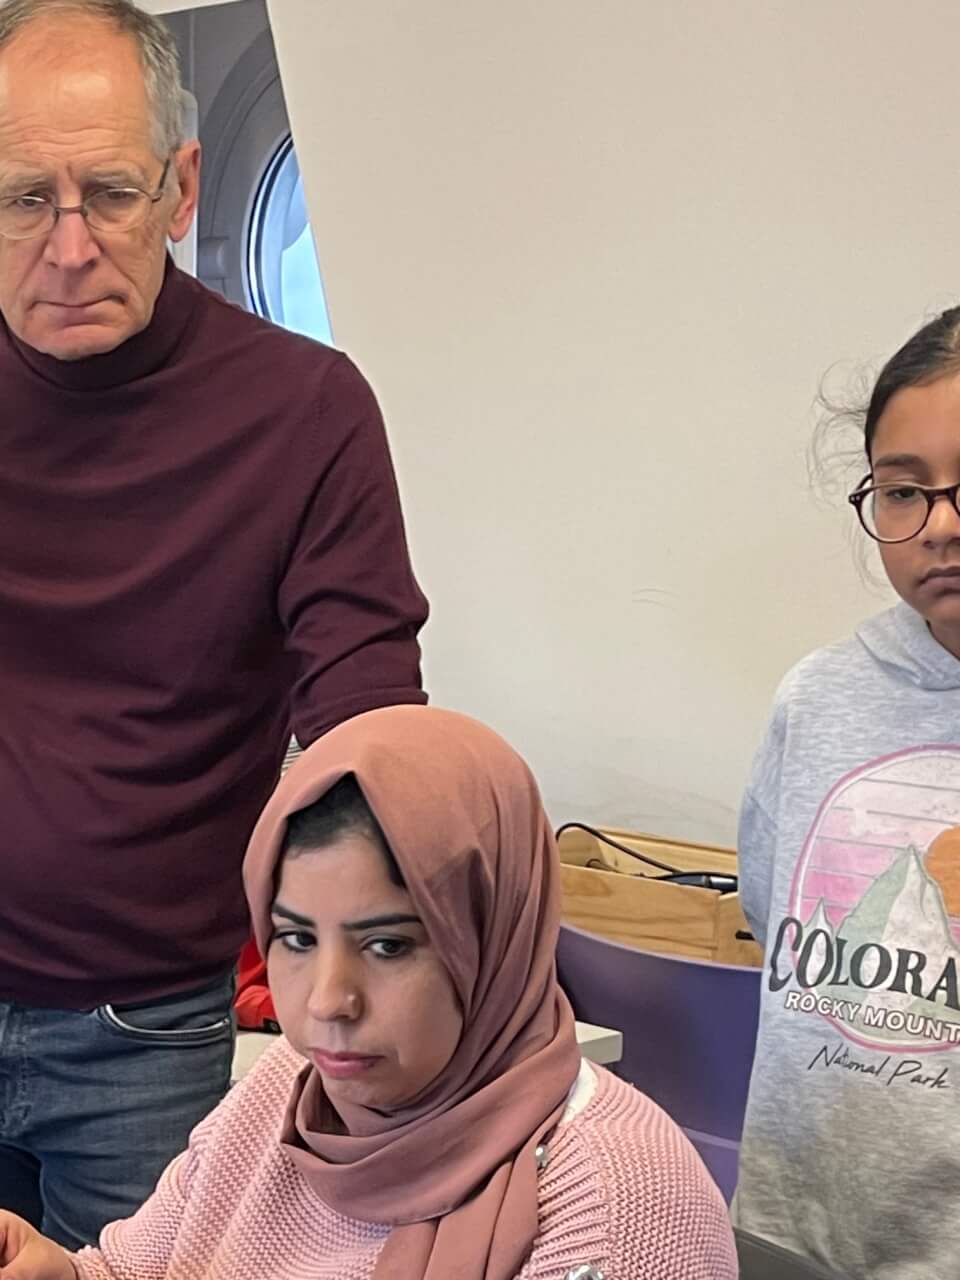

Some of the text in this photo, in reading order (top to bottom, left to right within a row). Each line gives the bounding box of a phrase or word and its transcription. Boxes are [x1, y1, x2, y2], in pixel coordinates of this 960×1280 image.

[768, 916, 960, 1011] COLORA
[784, 990, 860, 1022] ROCKY
[807, 1043, 951, 1089] National Park
